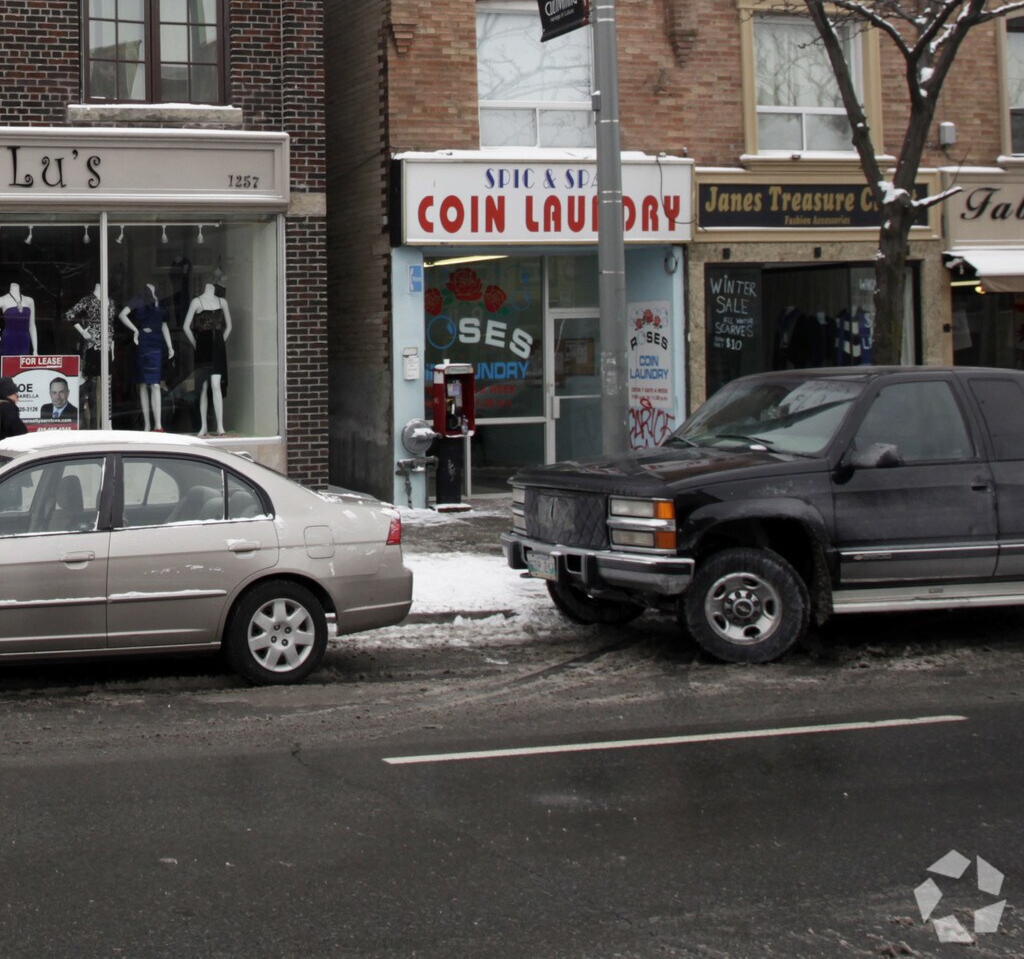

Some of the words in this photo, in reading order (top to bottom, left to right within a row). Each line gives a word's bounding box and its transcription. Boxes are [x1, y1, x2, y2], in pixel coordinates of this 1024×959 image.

[7, 145, 102, 189] Lu's
[227, 174, 260, 189] 1257
[484, 168, 535, 190] SPIC
[543, 168, 557, 189] &
[705, 186, 762, 212] Janes
[769, 186, 855, 212] Treasure
[417, 195, 505, 233] COIN
[716, 295, 750, 315] SALE
[715, 322, 754, 337] SCARVES
[726, 338, 743, 351] $10
[639, 355, 659, 367] COIN
[630, 368, 669, 380] LAUNDRY
[18, 384, 33, 392] OE
